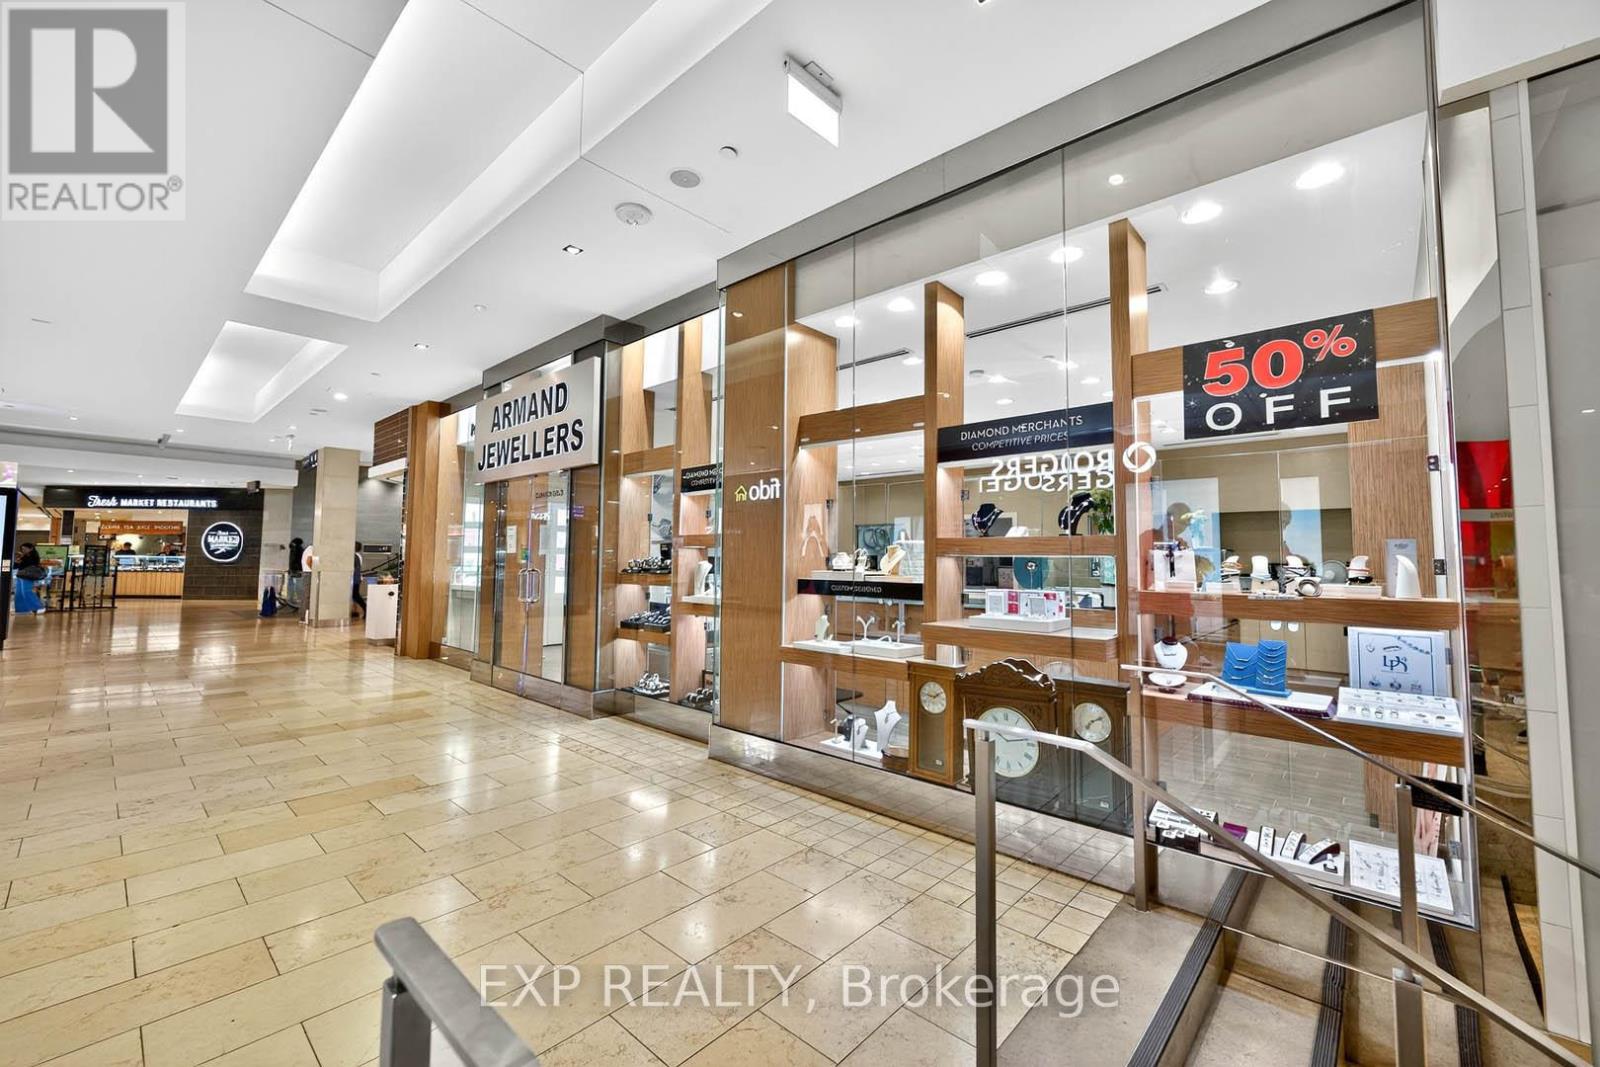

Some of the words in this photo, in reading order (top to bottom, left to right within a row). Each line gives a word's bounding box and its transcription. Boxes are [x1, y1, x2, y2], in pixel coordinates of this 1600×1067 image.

[1202, 323, 1358, 397] 50%
[490, 381, 569, 433] ARMAND
[960, 426, 1010, 441] DIAMOND
[1011, 415, 1083, 434] MERCHANTS
[1204, 385, 1352, 431] OFF
[477, 417, 585, 472] JEWELLERS
[971, 435, 1032, 451] COMPETITIVE
[1033, 430, 1069, 444] PRICES
[87, 495, 119, 508] Fresh
[120, 498, 155, 508] MARKET
[156, 499, 218, 508] RESTAURANTS
